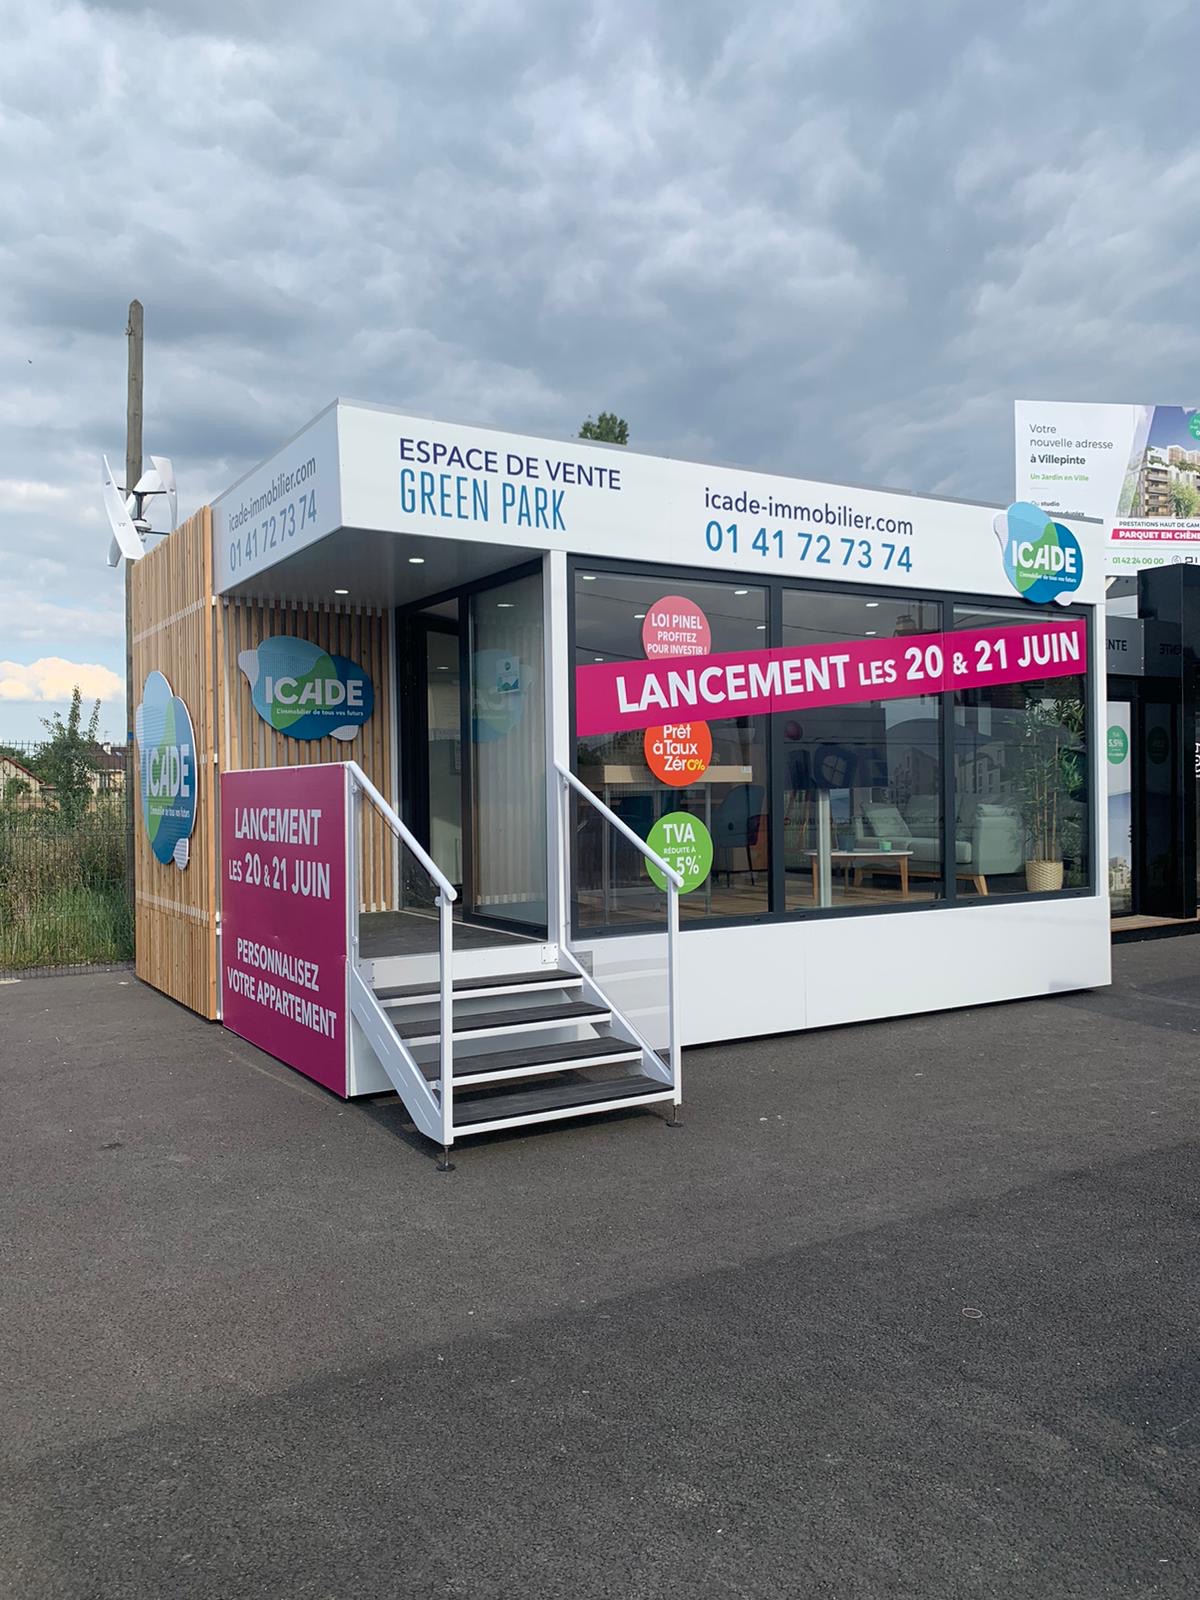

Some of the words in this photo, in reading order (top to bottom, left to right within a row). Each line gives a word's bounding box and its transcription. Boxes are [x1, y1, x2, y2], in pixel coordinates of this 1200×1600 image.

[1029, 424, 1056, 434] Votre
[1030, 438, 1073, 448] nouvelle
[1075, 439, 1113, 450] adresse
[400, 437, 498, 473] ESPACE
[506, 454, 539, 479] DE
[545, 459, 621, 490] VENTE
[1030, 454, 1037, 464] à
[1038, 454, 1086, 466] Villepinte
[1042, 473, 1064, 481] Jardin
[1074, 474, 1089, 482] Ville
[229, 457, 316, 533] icade-immobilier.com
[400, 468, 489, 522] GREEN
[502, 482, 566, 531] PARK
[704, 487, 913, 535] icade-immobilier.com
[230, 538, 242, 571] 01
[245, 528, 258, 560] 41
[262, 516, 277, 552] 72
[280, 503, 296, 541] 73
[299, 489, 317, 530] 74
[1119, 530, 1160, 540] PARQUET
[1161, 531, 1172, 539] EN
[705, 520, 738, 553] 01
[752, 528, 783, 559] 41
[797, 532, 831, 564] 72
[840, 538, 872, 569] 73
[881, 543, 912, 572] 74
[1012, 540, 1077, 573] ICADE
[1131, 557, 1140, 565] 24
[1142, 557, 1152, 565] 00
[1153, 557, 1164, 565] 00
[651, 613, 670, 628] LOI
[672, 614, 703, 630] PINEL
[657, 631, 697, 643] PROFITEZ
[647, 643, 669, 654] POUR
[670, 644, 703, 656] INVESTIR
[1106, 640, 1127, 652] NTE
[616, 655, 850, 714] LANCEMENT
[858, 659, 897, 686] LES
[904, 645, 944, 681] 20
[953, 652, 969, 675] &
[974, 638, 1007, 673] 21
[1017, 631, 1080, 668] JUIN
[265, 676, 363, 707] ICADE
[653, 739, 663, 755] à
[664, 739, 698, 755] Taux
[663, 724, 692, 739] Prêt
[145, 743, 190, 798] ICADE
[235, 807, 322, 846] LANCEMENT
[663, 822, 696, 844] TVA
[228, 859, 242, 882] LES
[245, 852, 261, 885] 20
[264, 864, 270, 887] &
[272, 855, 287, 891] 21
[291, 859, 330, 899] JUIN
[237, 937, 319, 992] PERSONNALISEZ
[227, 966, 255, 1001] VOTRE
[256, 980, 337, 1039] APPARTEMENT
